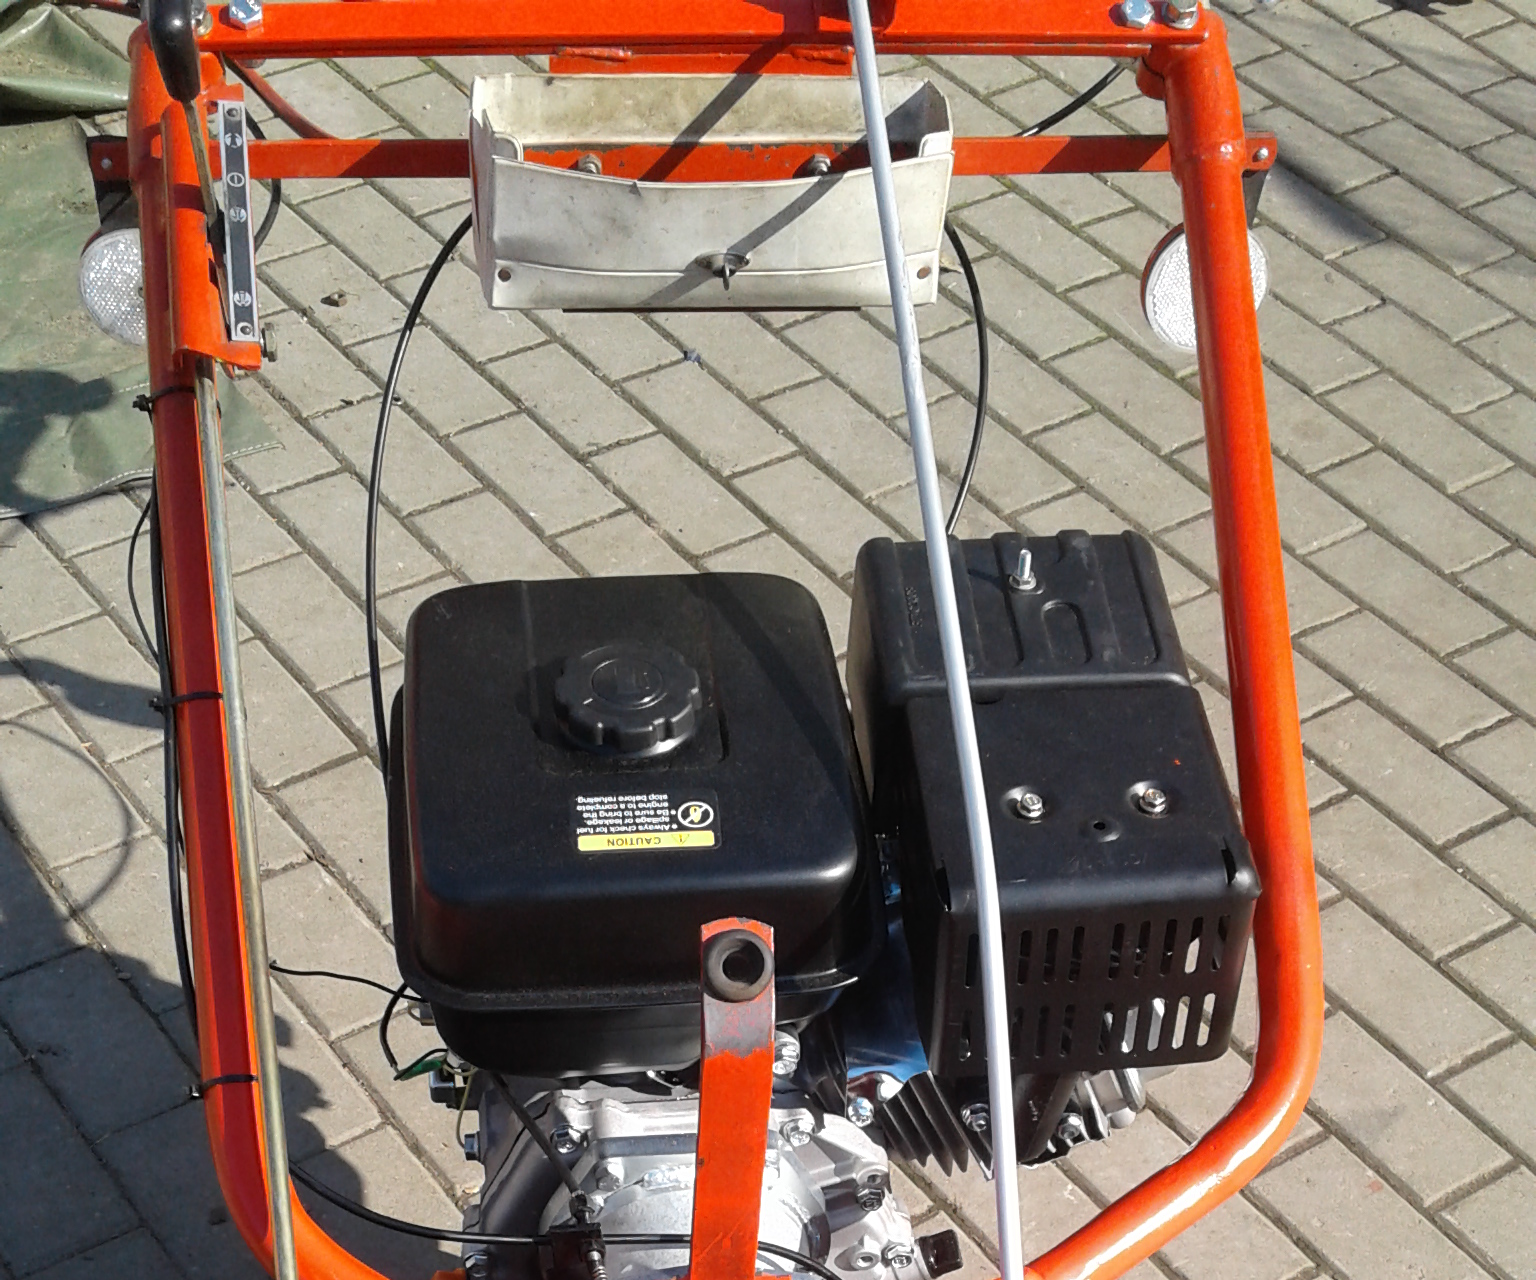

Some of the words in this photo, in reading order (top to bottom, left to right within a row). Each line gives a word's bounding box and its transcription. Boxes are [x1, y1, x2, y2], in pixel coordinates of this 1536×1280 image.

[577, 803, 618, 811] complete
[638, 801, 668, 809] engine
[638, 823, 670, 831] Always
[607, 837, 661, 846] CAUTION
